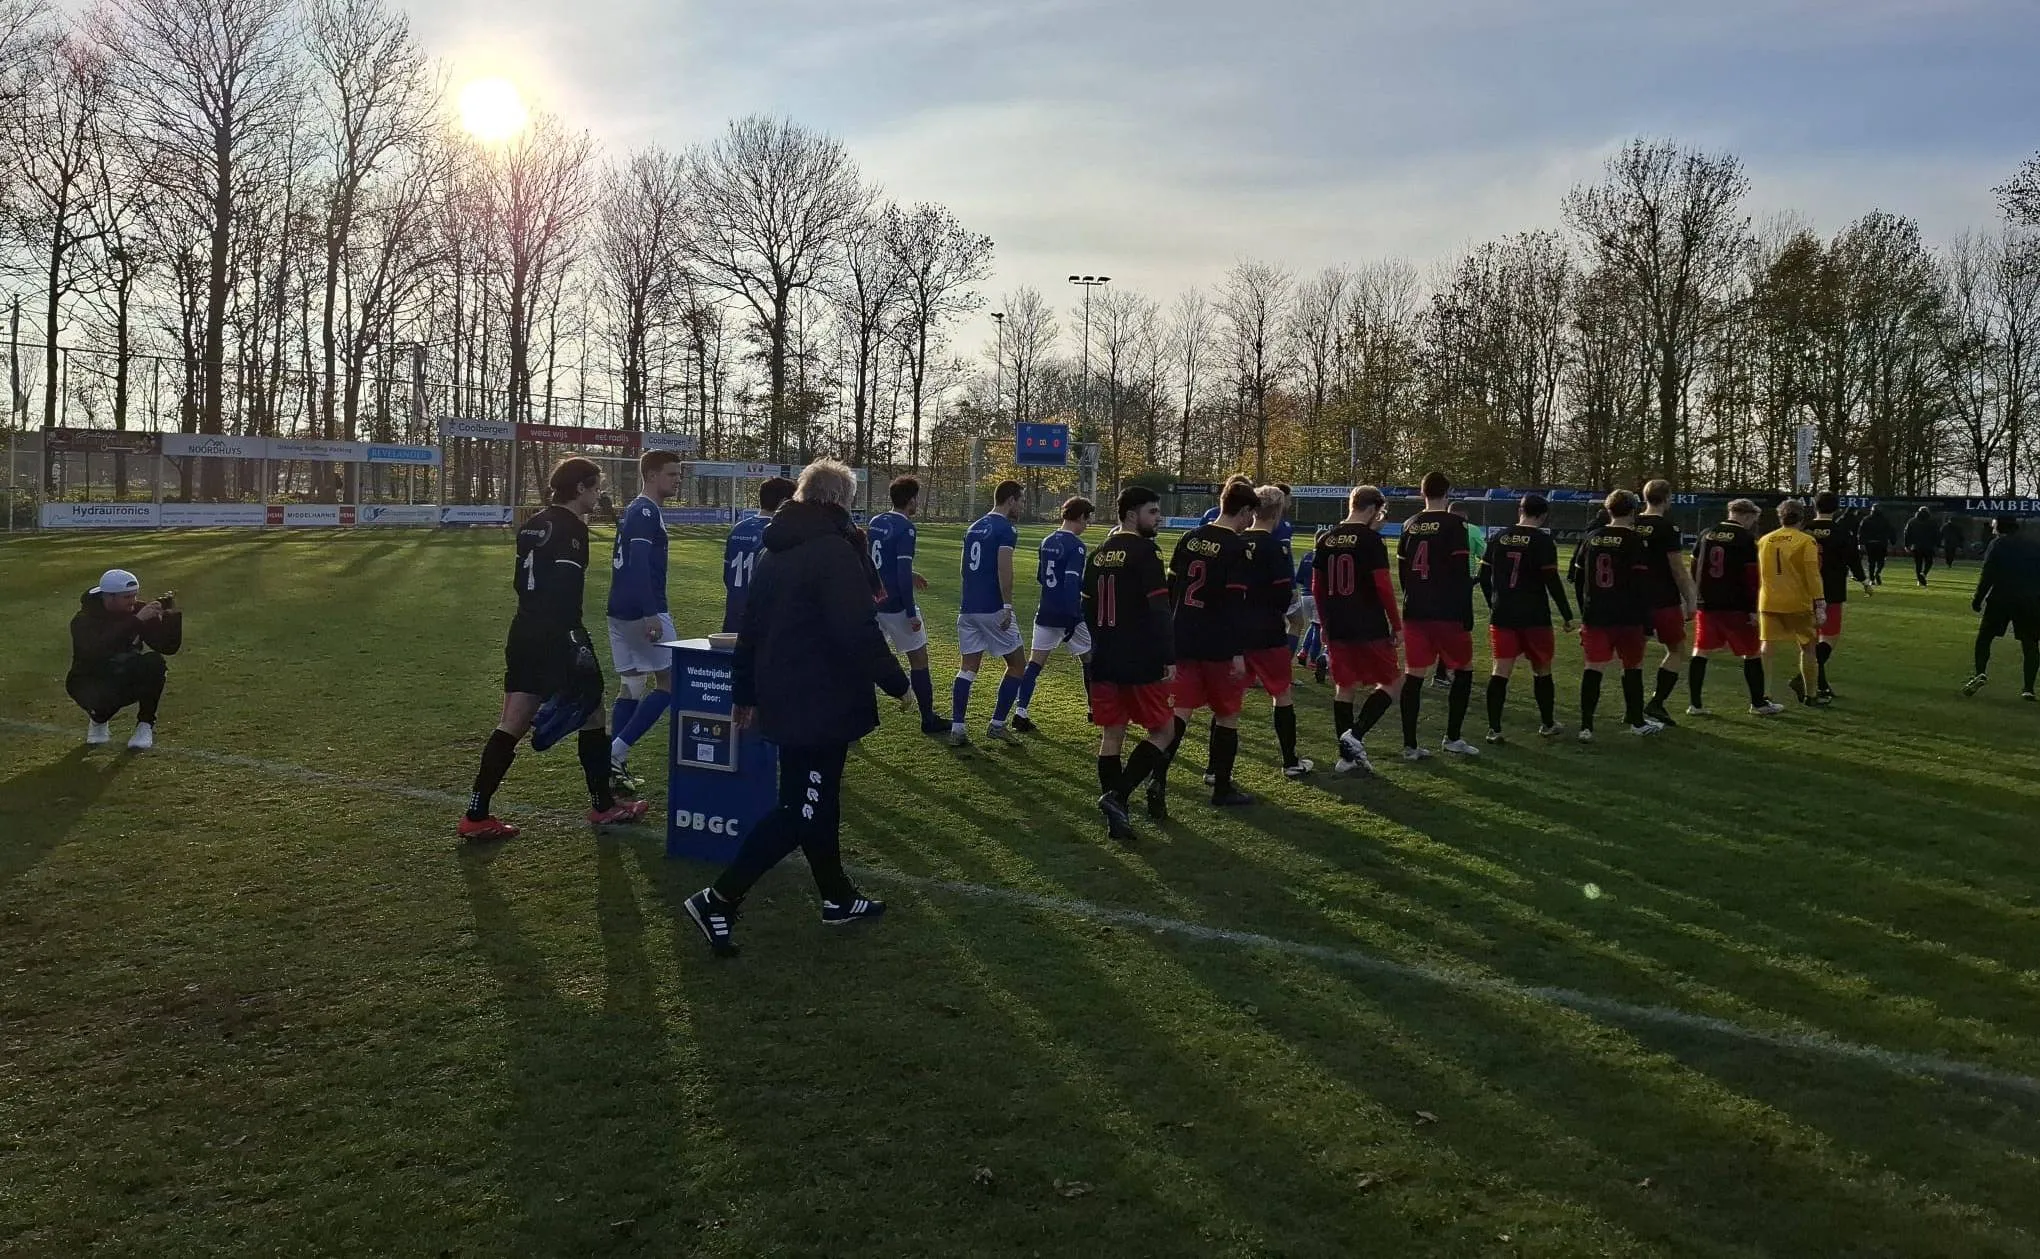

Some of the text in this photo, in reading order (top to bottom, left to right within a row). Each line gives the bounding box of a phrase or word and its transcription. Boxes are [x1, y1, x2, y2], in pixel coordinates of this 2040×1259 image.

[459, 422, 508, 436] Coolbergen
[531, 430, 550, 438] wees
[552, 429, 568, 440] wijs
[648, 436, 685, 447] Coolbergen
[188, 445, 242, 455] NOORDHUYS
[72, 505, 150, 518] Hydrautronics
[523, 549, 535, 591] 1
[731, 551, 754, 587] 11
[871, 540, 883, 570] 6
[969, 541, 981, 571] 9
[1411, 540, 1430, 580] 4
[1709, 546, 1726, 578] 9
[1776, 548, 1782, 576] 1
[1046, 560, 1058, 588] 5
[1184, 560, 1206, 608] 2
[1327, 553, 1355, 596] 10
[1506, 552, 1522, 589] 7
[1595, 553, 1614, 588] 8
[1097, 574, 1116, 627] 11
[687, 666, 731, 679] Wedstrijdbal
[702, 693, 721, 702] door:
[676, 809, 739, 837] DBGC
